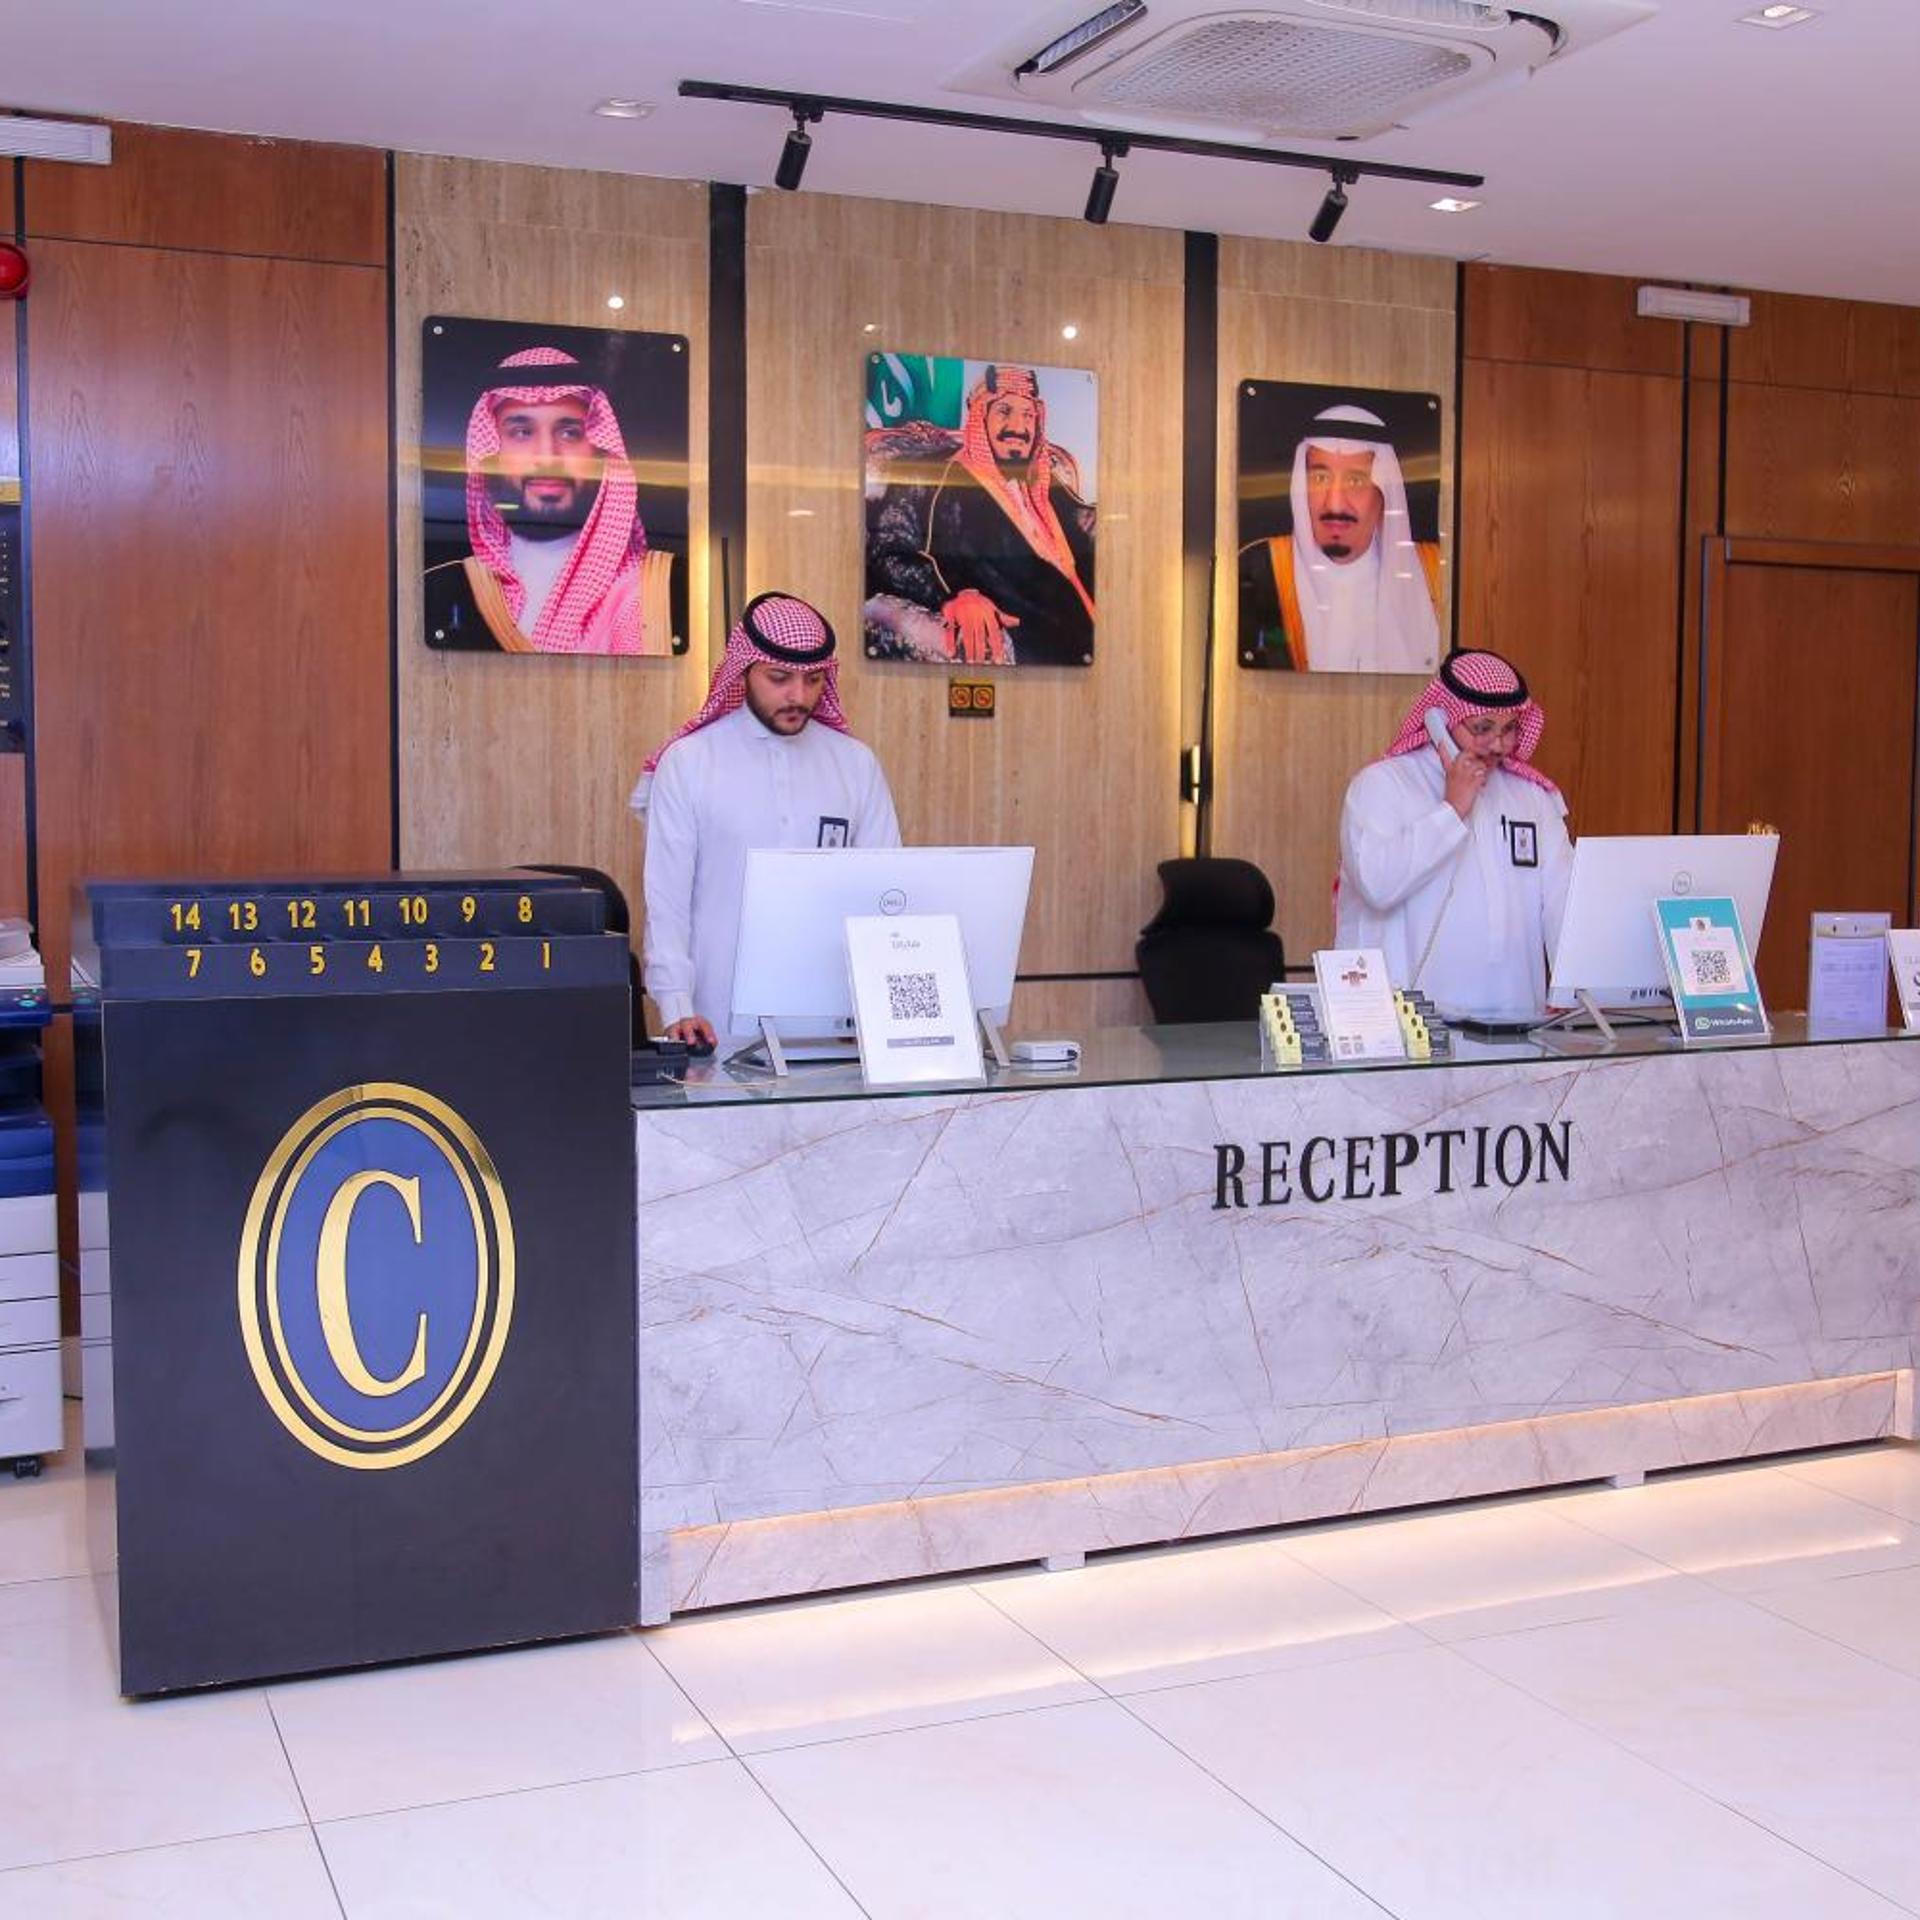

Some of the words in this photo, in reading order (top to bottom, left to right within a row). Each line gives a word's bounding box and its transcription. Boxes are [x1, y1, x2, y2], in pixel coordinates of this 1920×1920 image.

[170, 903, 201, 931] 14
[229, 902, 258, 931] 13
[287, 900, 316, 929] 12
[344, 899, 371, 927] 11
[399, 896, 428, 924] 10
[460, 895, 476, 923] 9
[518, 895, 533, 923] 8
[186, 949, 202, 977] 7
[249, 948, 266, 977] 6
[310, 945, 326, 975] 5
[366, 944, 383, 972] 4
[425, 943, 438, 973] 3
[480, 942, 495, 972] 2
[541, 941, 551, 969] 1
[1211, 1120, 1574, 1210] RECEPTION
[316, 1169, 427, 1397] C
